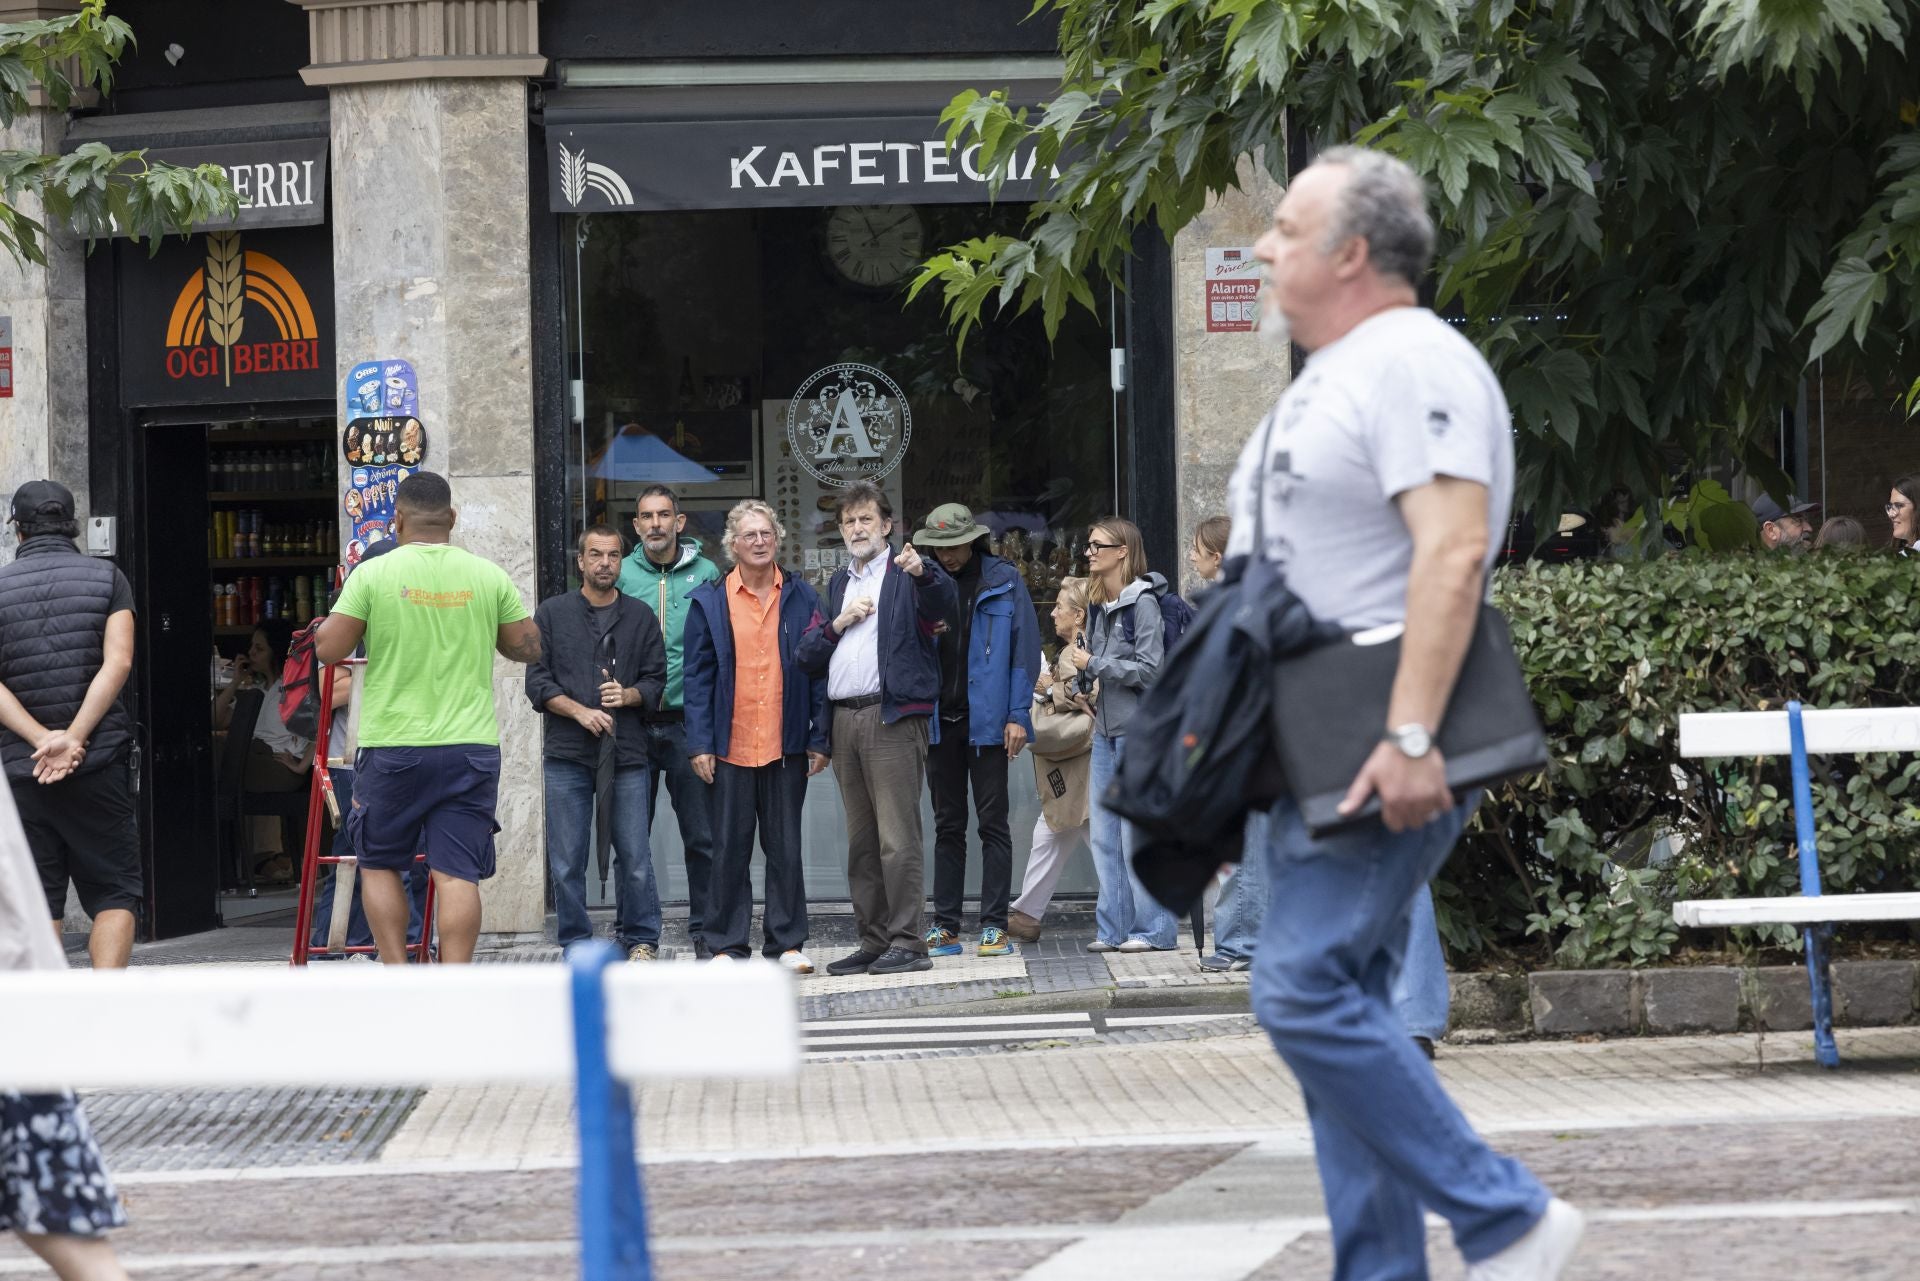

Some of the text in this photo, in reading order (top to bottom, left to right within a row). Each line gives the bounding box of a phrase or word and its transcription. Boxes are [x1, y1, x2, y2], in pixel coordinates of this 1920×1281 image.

[222, 160, 314, 209] ERRI
[1211, 283, 1256, 294] Alarma
[166, 341, 320, 379] OGI BERRI
[355, 366, 378, 381] OREO
[815, 387, 880, 459] A
